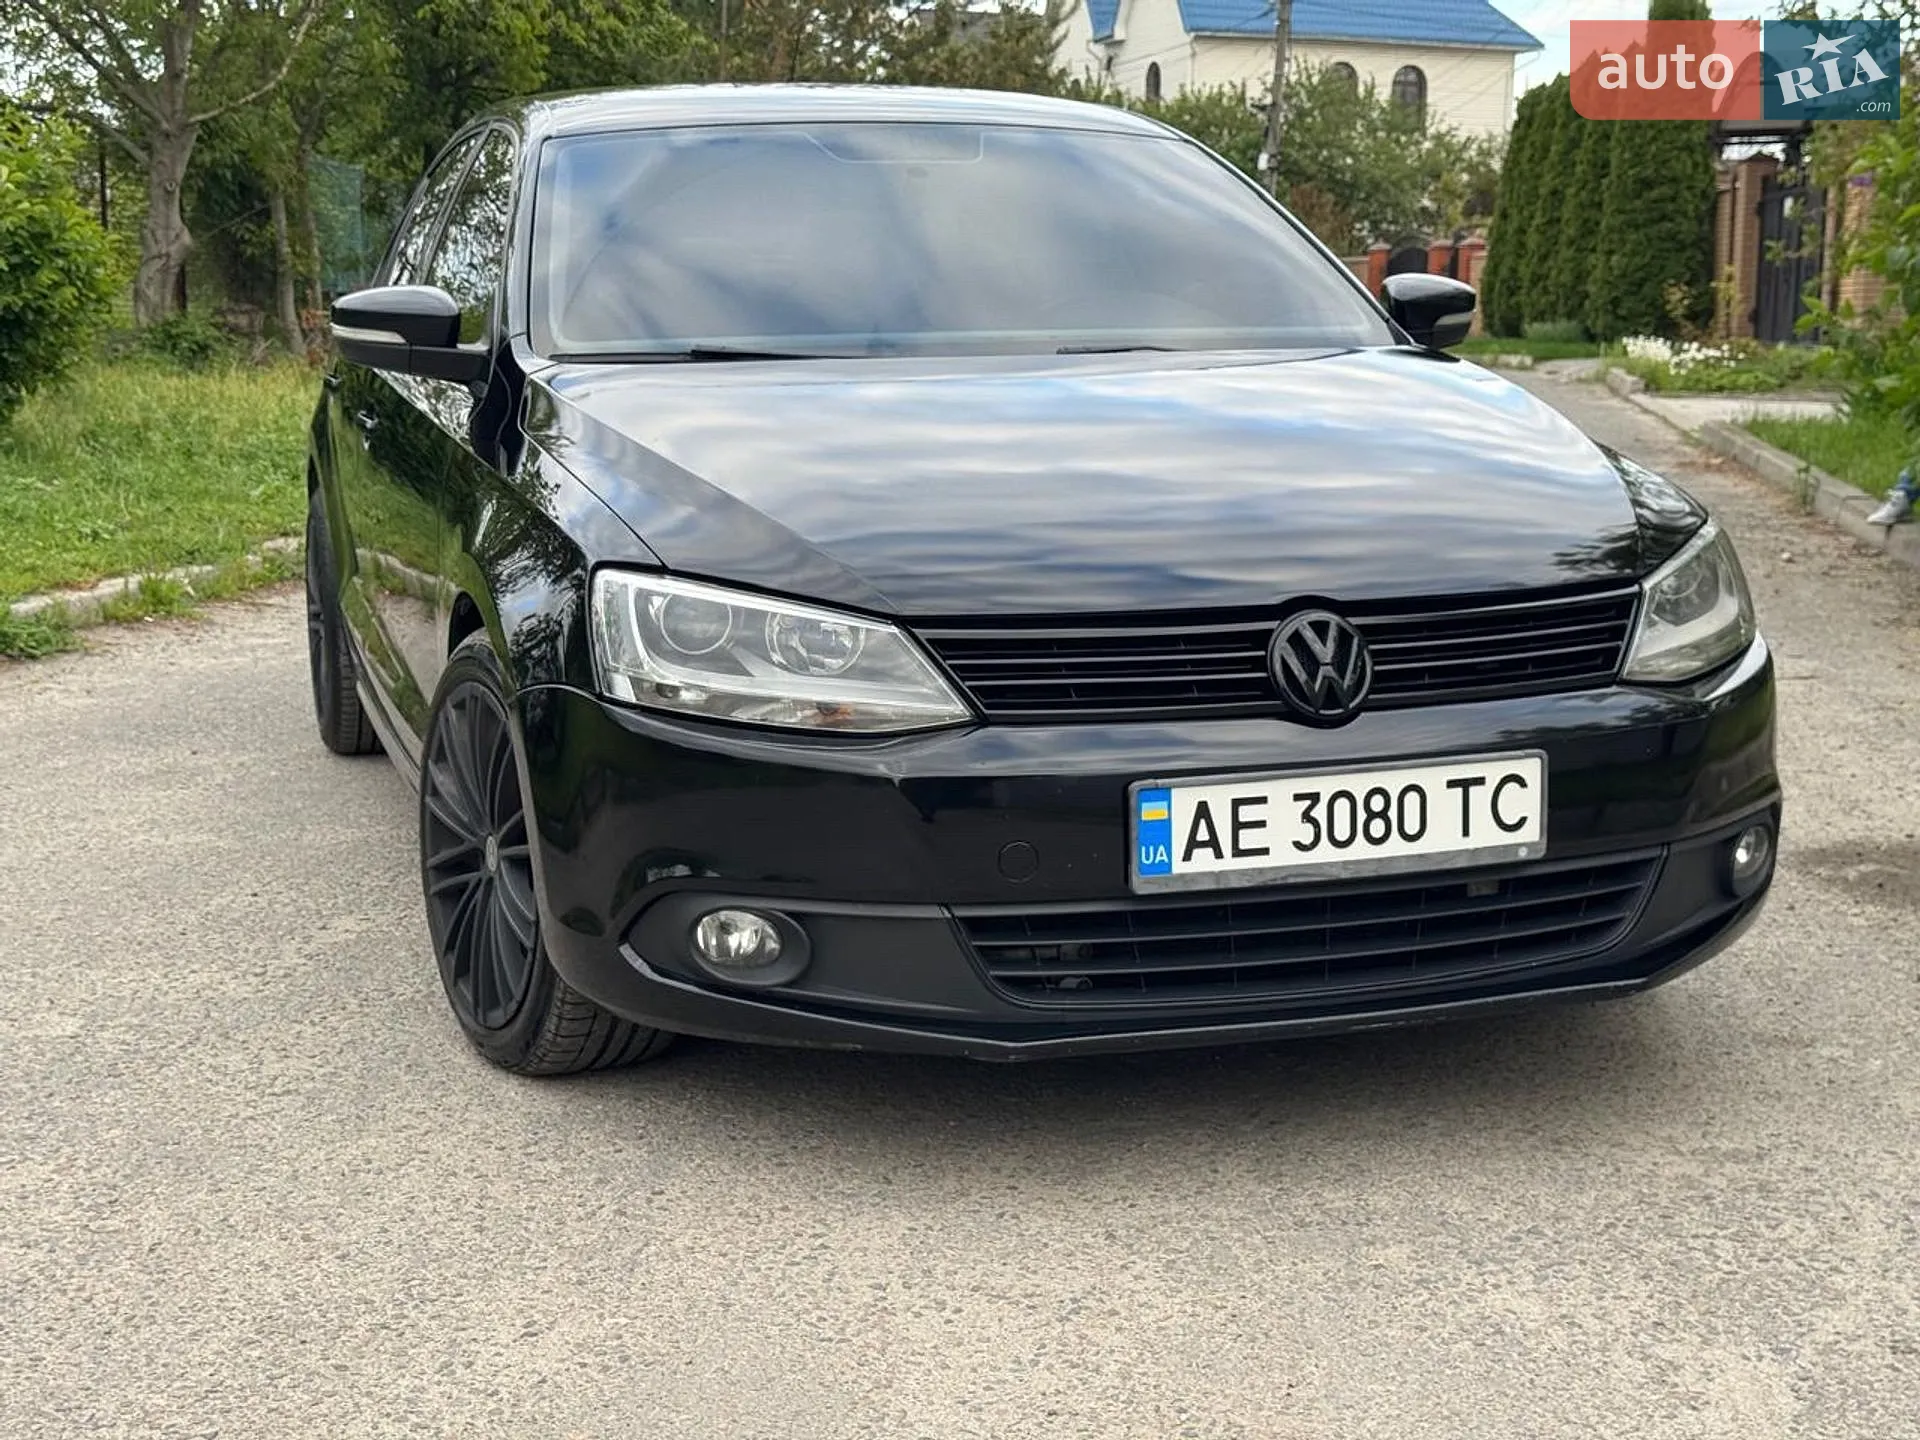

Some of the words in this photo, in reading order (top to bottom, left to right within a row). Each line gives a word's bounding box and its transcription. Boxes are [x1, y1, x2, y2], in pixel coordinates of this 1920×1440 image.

[1182, 796, 1270, 862] AE
[1292, 783, 1427, 852] 3080
[1446, 773, 1528, 838] TC
[1141, 847, 1169, 864] UA
